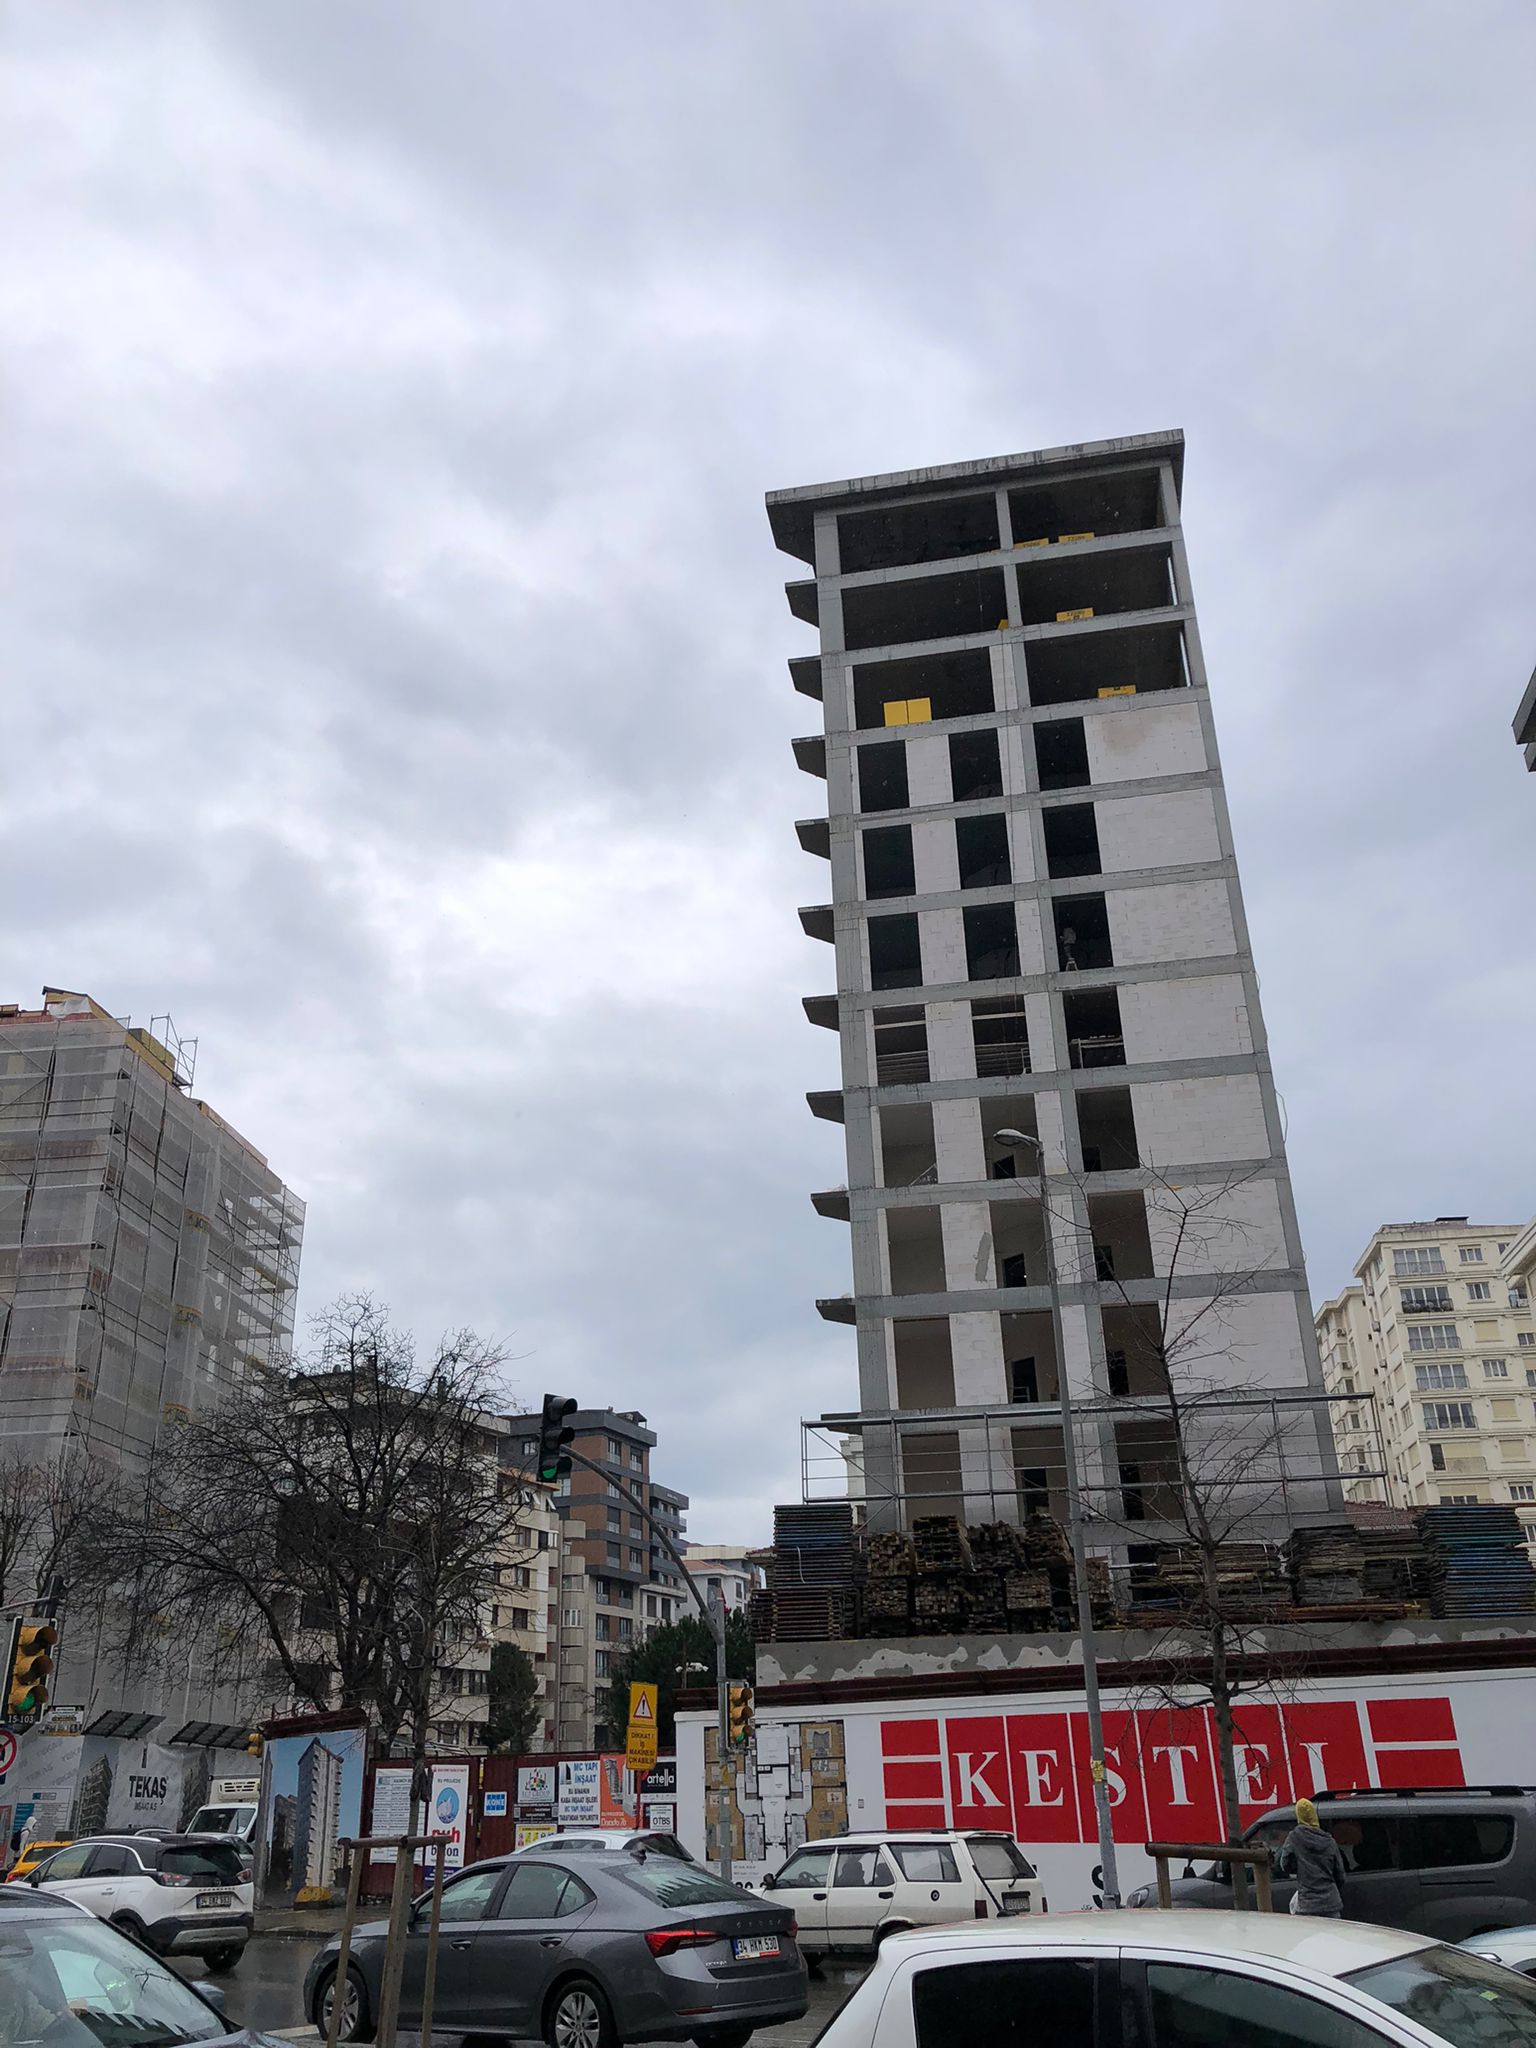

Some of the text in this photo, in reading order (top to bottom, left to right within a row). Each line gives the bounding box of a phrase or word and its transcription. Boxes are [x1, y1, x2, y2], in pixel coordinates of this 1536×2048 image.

[585, 1762, 598, 1771] YAPI
[574, 1774, 597, 1785] İNŞAAT
[129, 1775, 168, 1805] TEKAŞ
[431, 1844, 459, 1857] bon
[737, 1940, 748, 1953] 34
